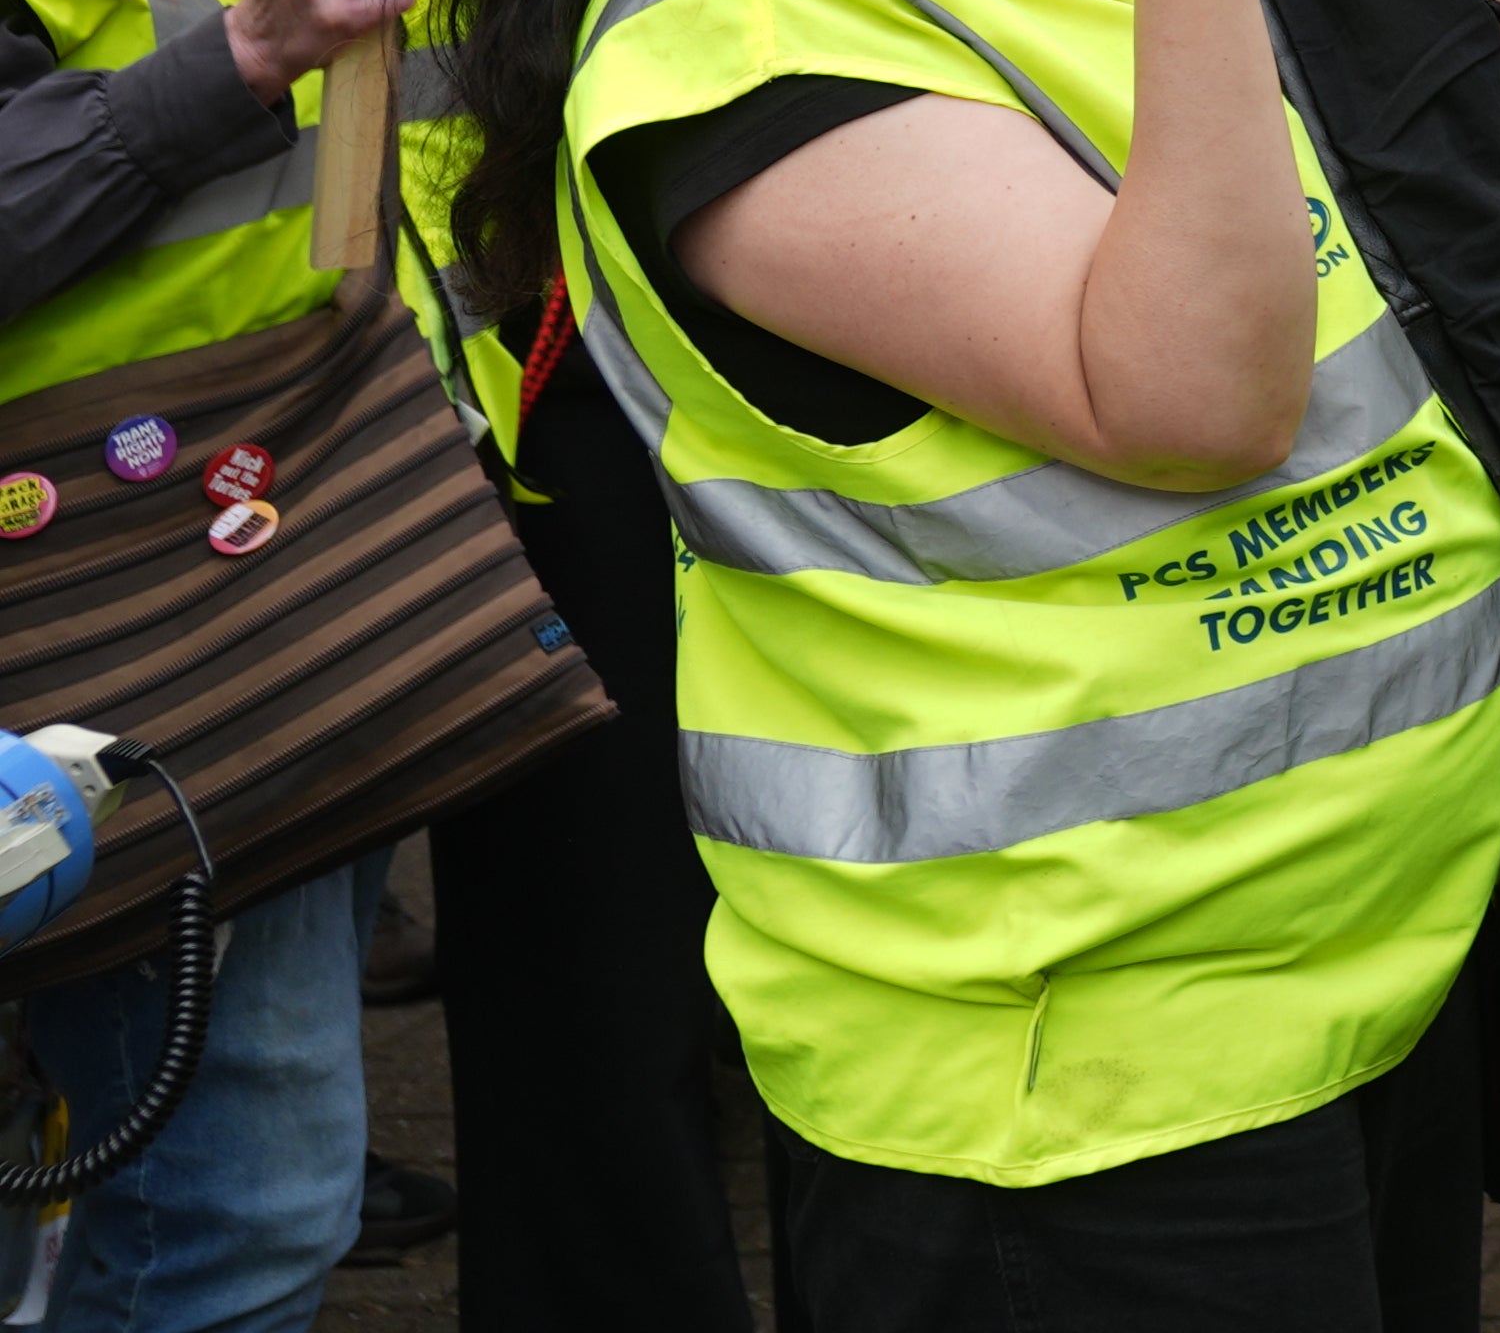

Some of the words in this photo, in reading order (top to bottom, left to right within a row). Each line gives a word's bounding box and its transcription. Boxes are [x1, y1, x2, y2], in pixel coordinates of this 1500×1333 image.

[112, 419, 159, 449] TRANS
[127, 444, 164, 470] NOW
[1117, 550, 1218, 602] PCS
[1227, 440, 1437, 570] MEMBERS
[1199, 553, 1437, 653] TOGETHER
